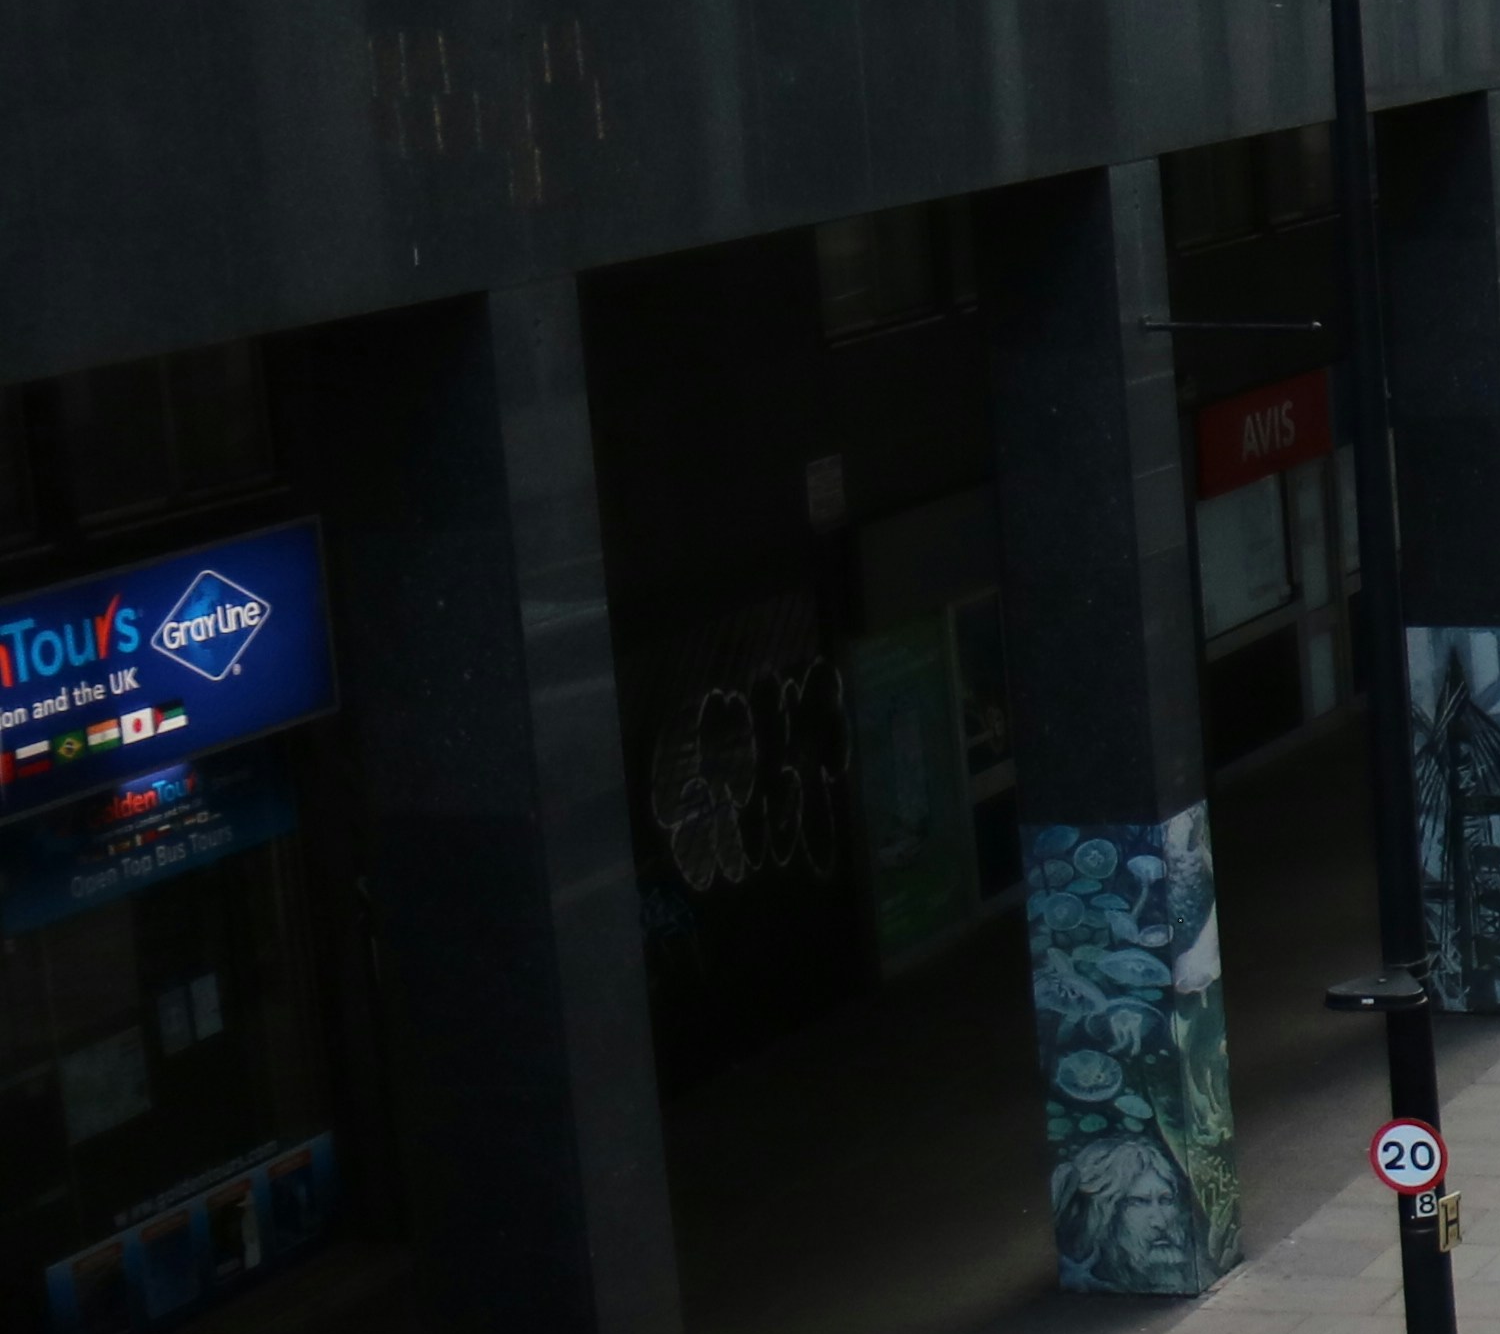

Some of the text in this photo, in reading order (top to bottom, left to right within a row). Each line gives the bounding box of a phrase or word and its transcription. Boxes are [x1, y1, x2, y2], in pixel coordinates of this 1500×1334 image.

[1240, 398, 1296, 464] AVIS
[32, 687, 70, 721] and
[72, 679, 106, 708] the
[108, 666, 141, 696] UK
[155, 841, 188, 867] Bus
[1382, 1140, 1436, 1171] 20
